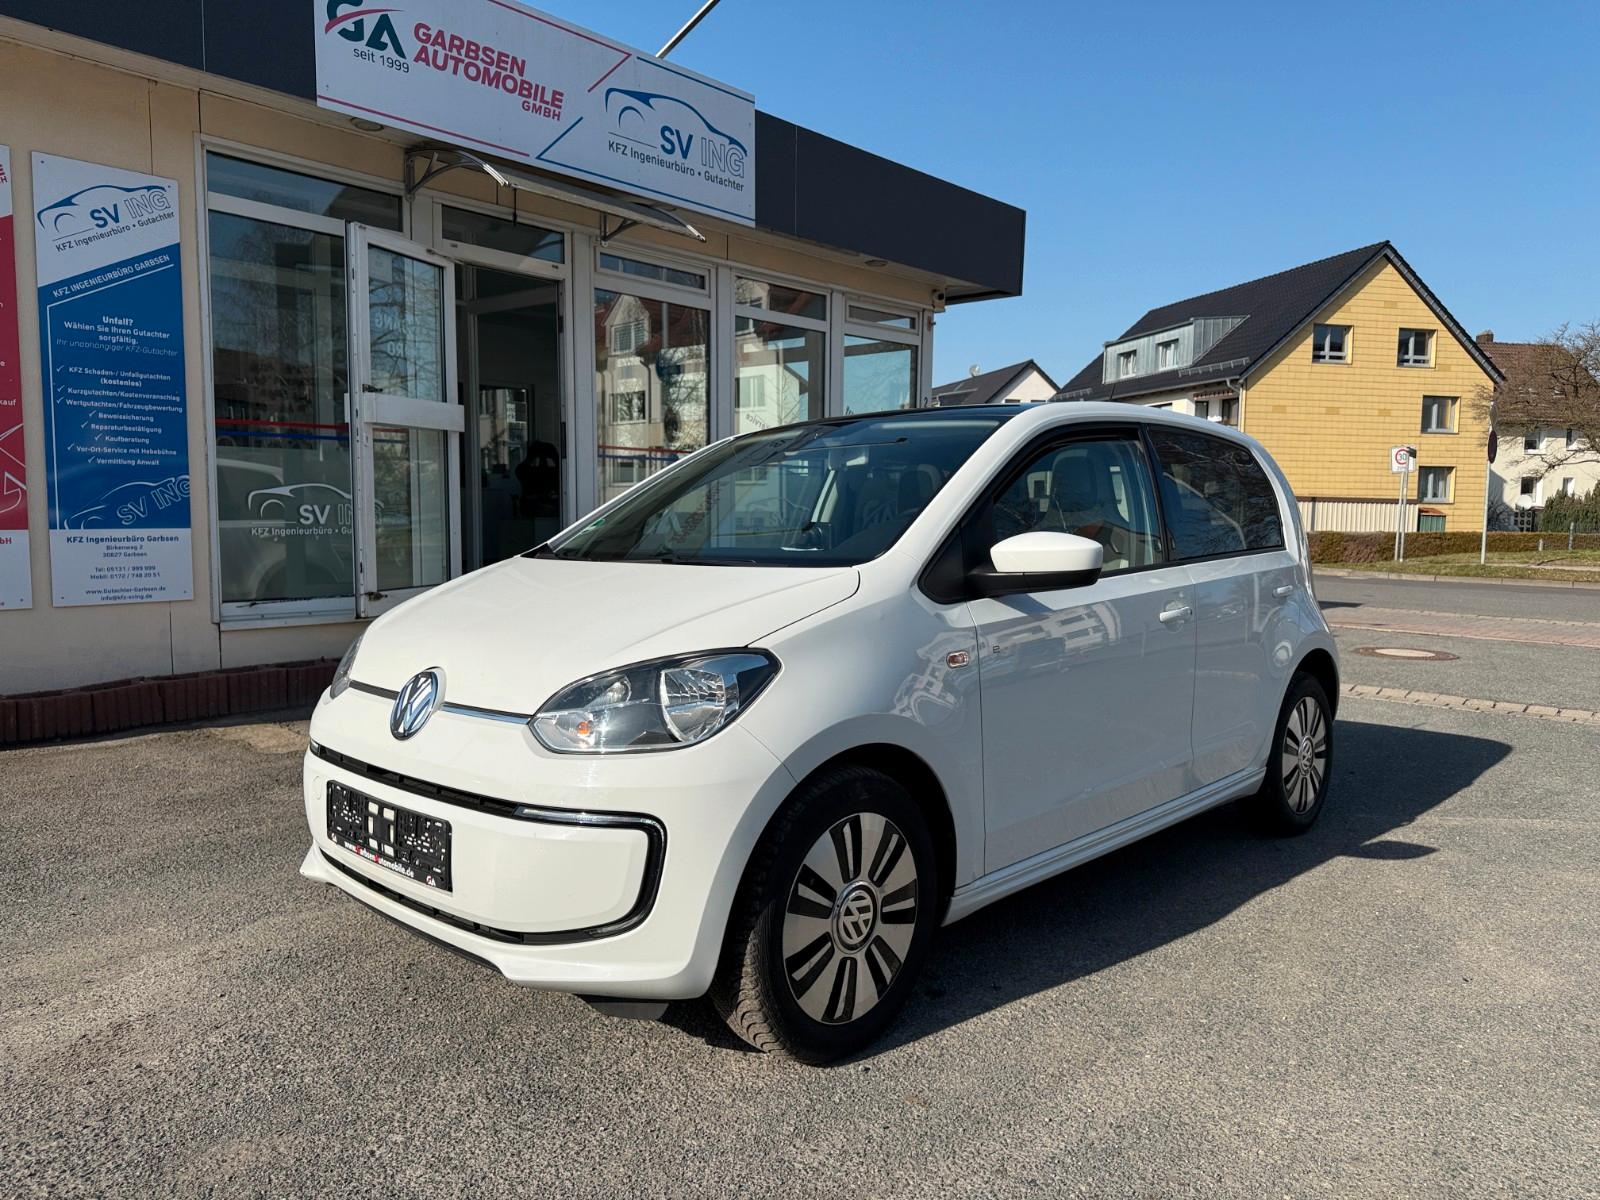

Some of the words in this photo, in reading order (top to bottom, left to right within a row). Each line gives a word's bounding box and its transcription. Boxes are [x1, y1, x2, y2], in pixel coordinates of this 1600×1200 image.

[413, 22, 526, 77] GARBSEN
[353, 48, 375, 63] seit
[380, 55, 410, 73] 1999
[413, 45, 564, 110] AUTOMOBILE
[521, 100, 561, 121] GMBH
[660, 125, 693, 160] SV
[700, 136, 745, 179] ING
[608, 140, 628, 156] KFZ
[630, 147, 695, 177] Ingenieurbüro
[704, 170, 745, 192] Gutachter
[89, 203, 120, 228] SV
[124, 189, 171, 219] ING
[55, 240, 74, 252] KFZ
[75, 224, 131, 246] Ingenieurbüro
[138, 211, 175, 228] Gutachter
[53, 286, 71, 298] KFZ
[70, 265, 134, 292] INGENIEURBÜRO
[134, 254, 170, 271] GARBSEN
[64, 321, 95, 331] Wählen
[96, 324, 109, 333] Sie
[111, 326, 132, 335] Ihren
[133, 328, 170, 339] Gutachter
[102, 315, 134, 327] Unfall?
[56, 338, 67, 346] Ihr
[98, 334, 138, 345] sorgfältig.
[68, 366, 82, 374] KFZ
[100, 378, 142, 388] (kostenlos)
[105, 435, 150, 444] Kaufberatung
[116, 496, 148, 525] SV
[151, 474, 189, 510] ING
[299, 504, 331, 525] SV
[86, 535, 145, 545] Ingenieurbüro
[146, 534, 179, 542] Garbsen
[251, 527, 270, 536] KFZ
[271, 526, 333, 537] Ingenieurbüro
